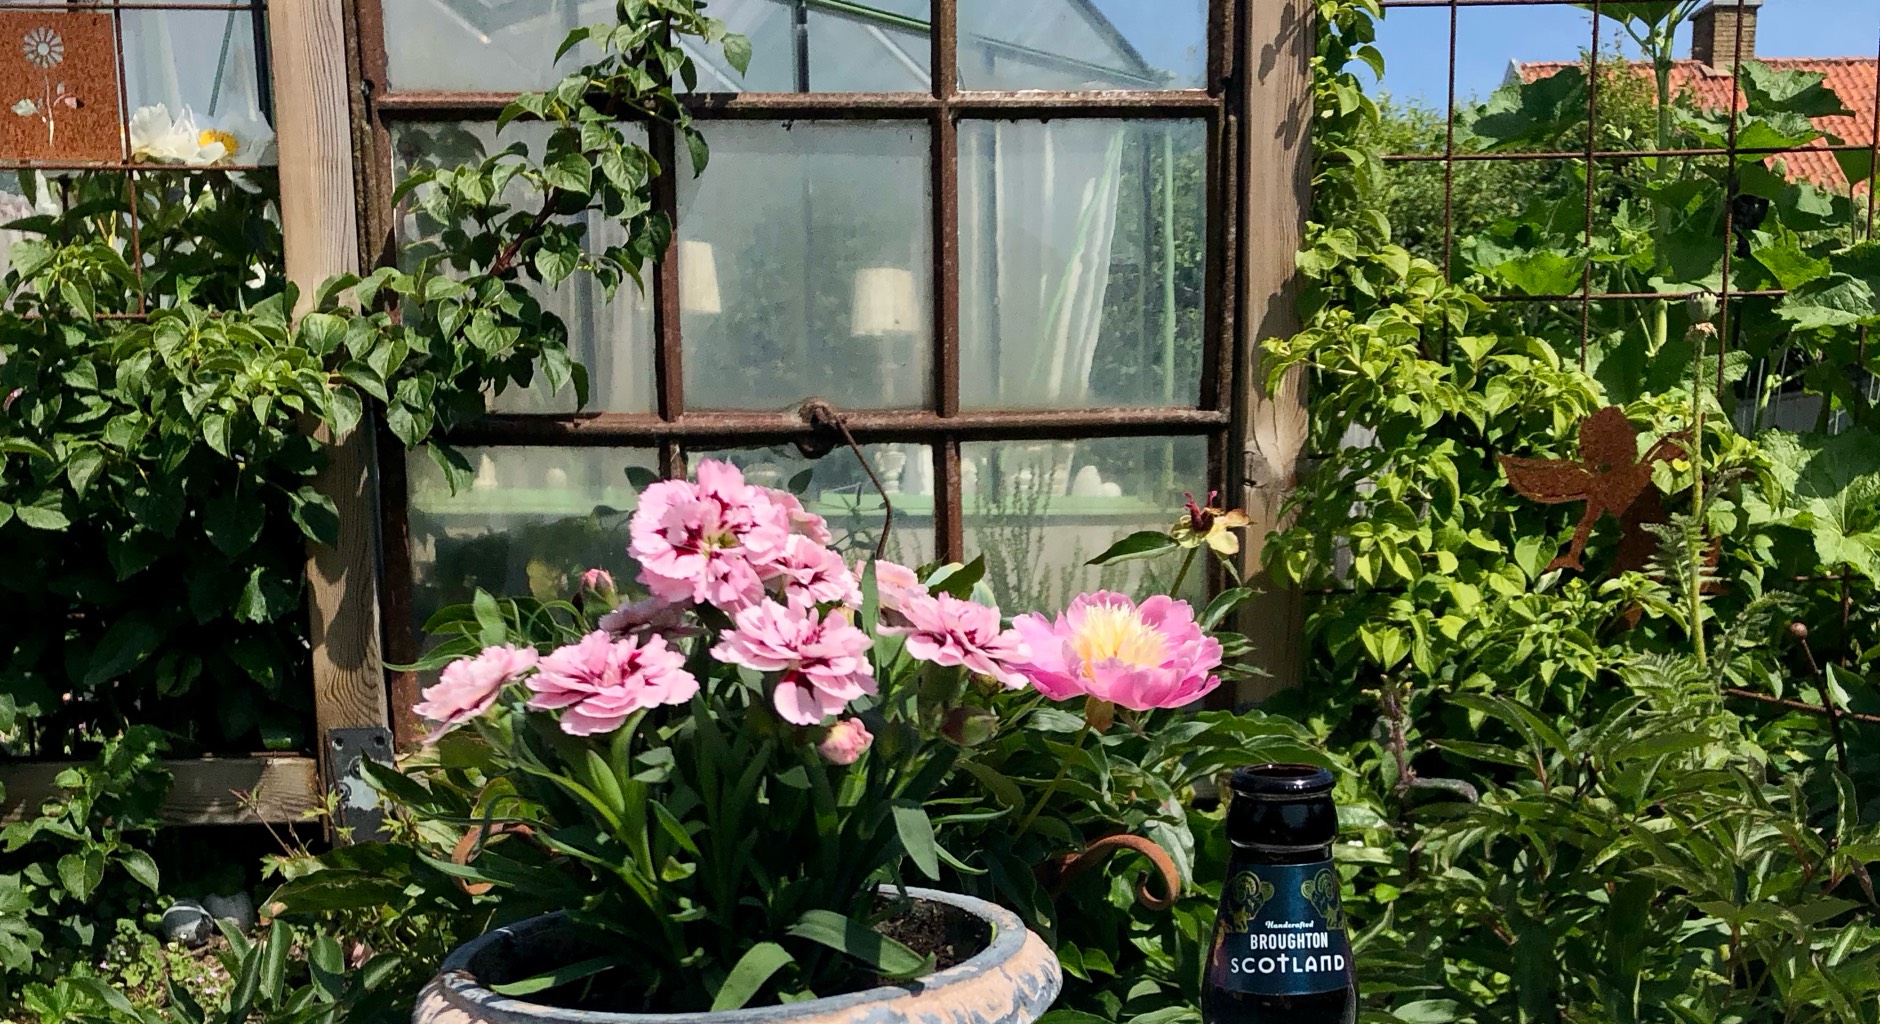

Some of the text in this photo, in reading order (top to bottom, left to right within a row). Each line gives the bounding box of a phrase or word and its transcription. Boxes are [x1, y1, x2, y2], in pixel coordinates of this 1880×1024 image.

[1265, 920, 1314, 929] Handcrafted
[1250, 932, 1329, 950] BROUGHTON
[1230, 953, 1345, 974] SCOTLAND
